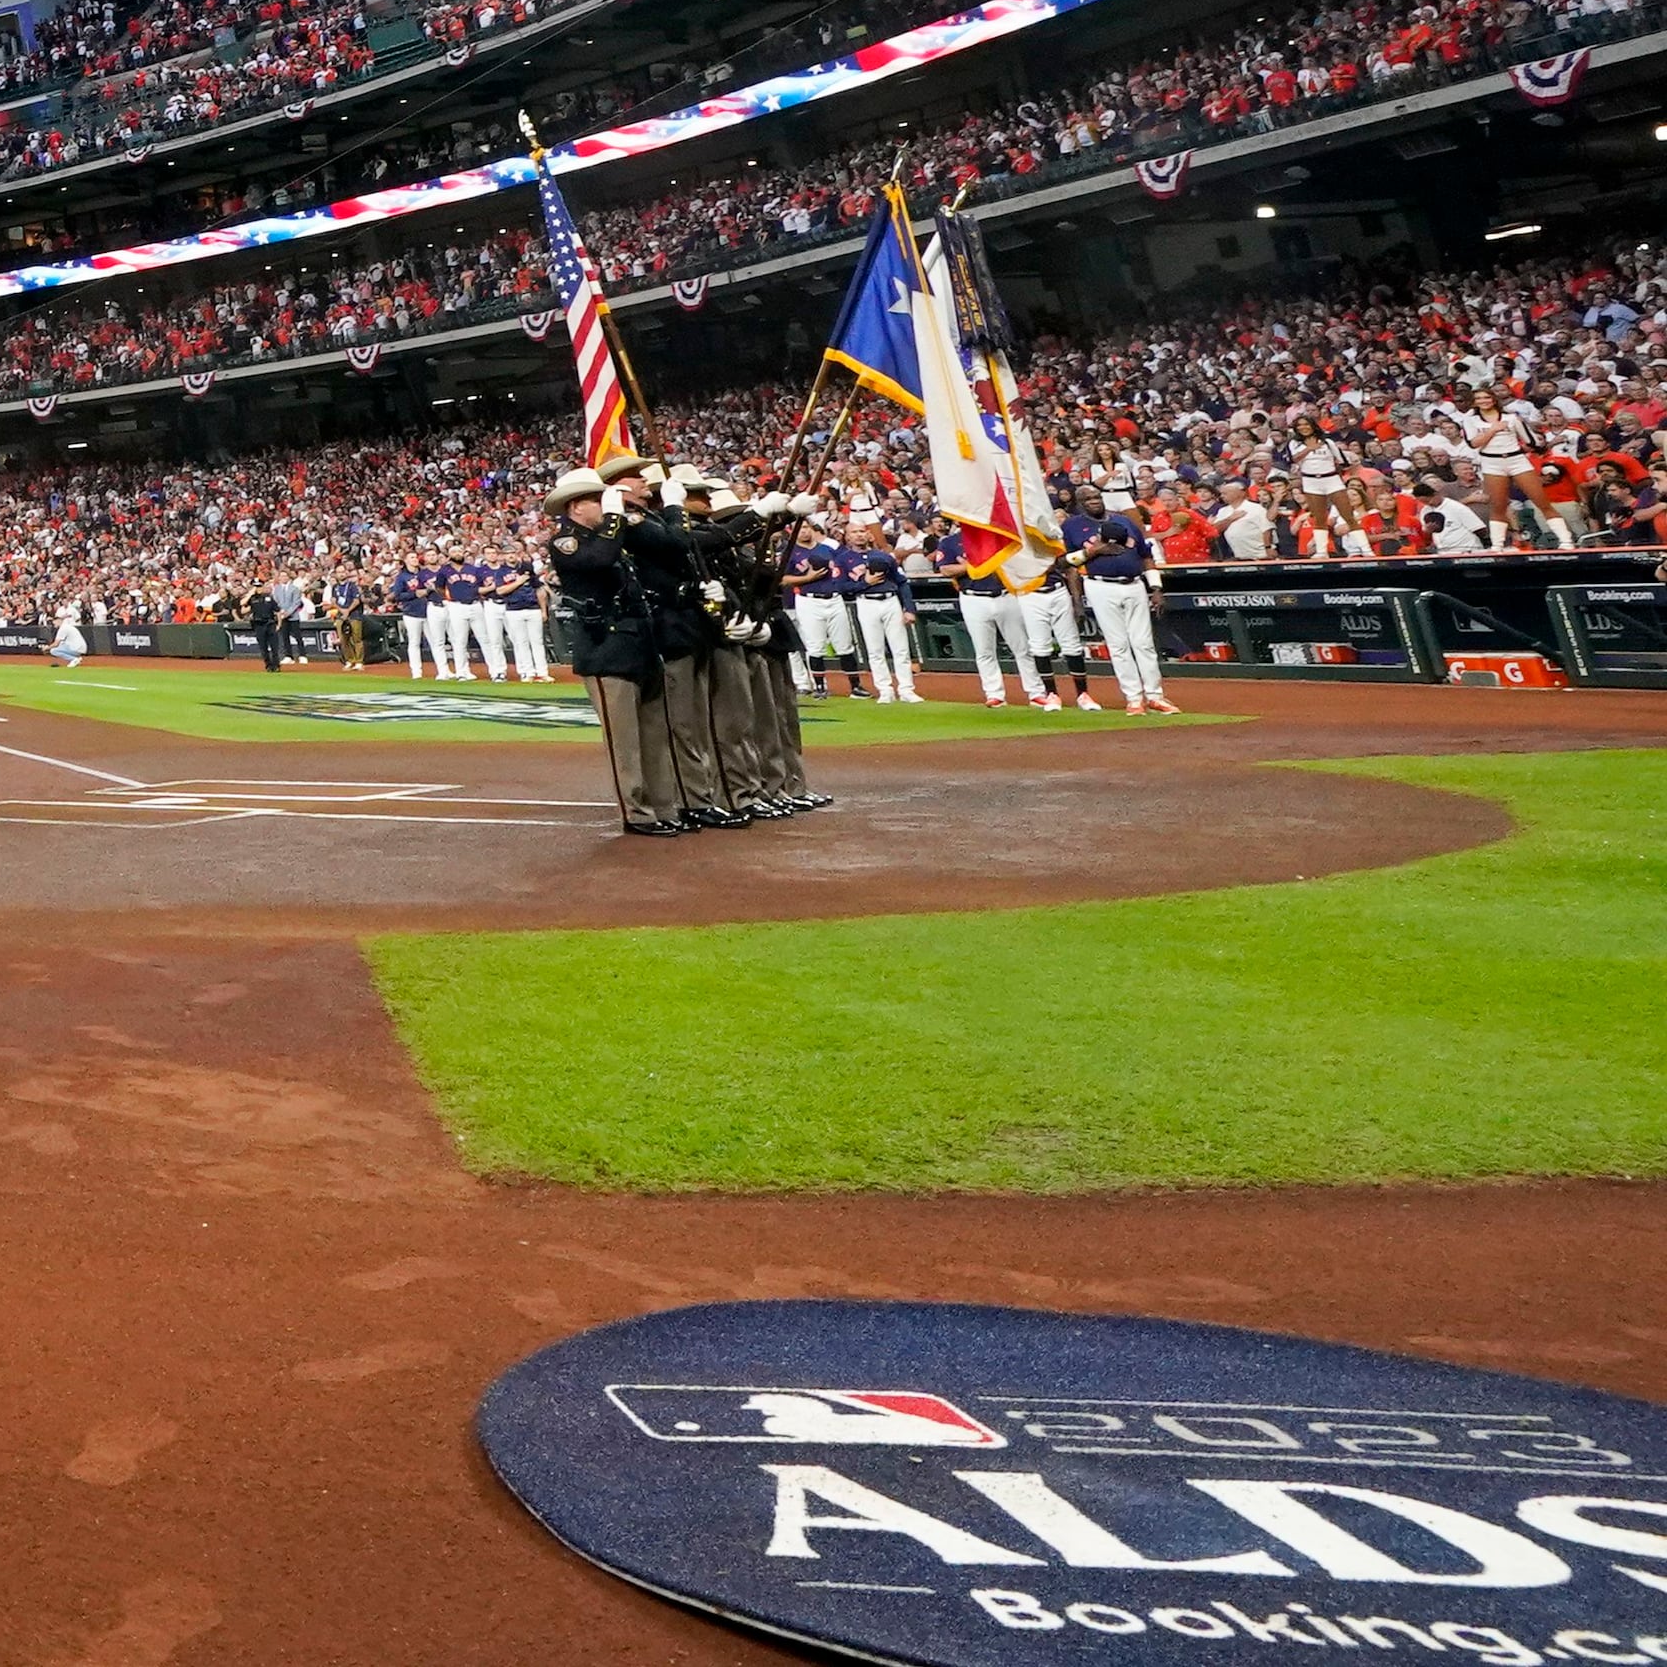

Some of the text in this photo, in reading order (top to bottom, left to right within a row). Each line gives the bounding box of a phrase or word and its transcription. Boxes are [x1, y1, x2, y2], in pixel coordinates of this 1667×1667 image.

[1208, 595, 1276, 607] POSTSEASON
[1323, 593, 1384, 606] Booking.com
[1586, 590, 1655, 603] Booking.com
[1340, 615, 1382, 631] ALDS
[1321, 646, 1333, 660] G
[1503, 662, 1526, 684] G
[1005, 1409, 1633, 1469] 2023
[759, 1461, 1667, 1591] ALDS
